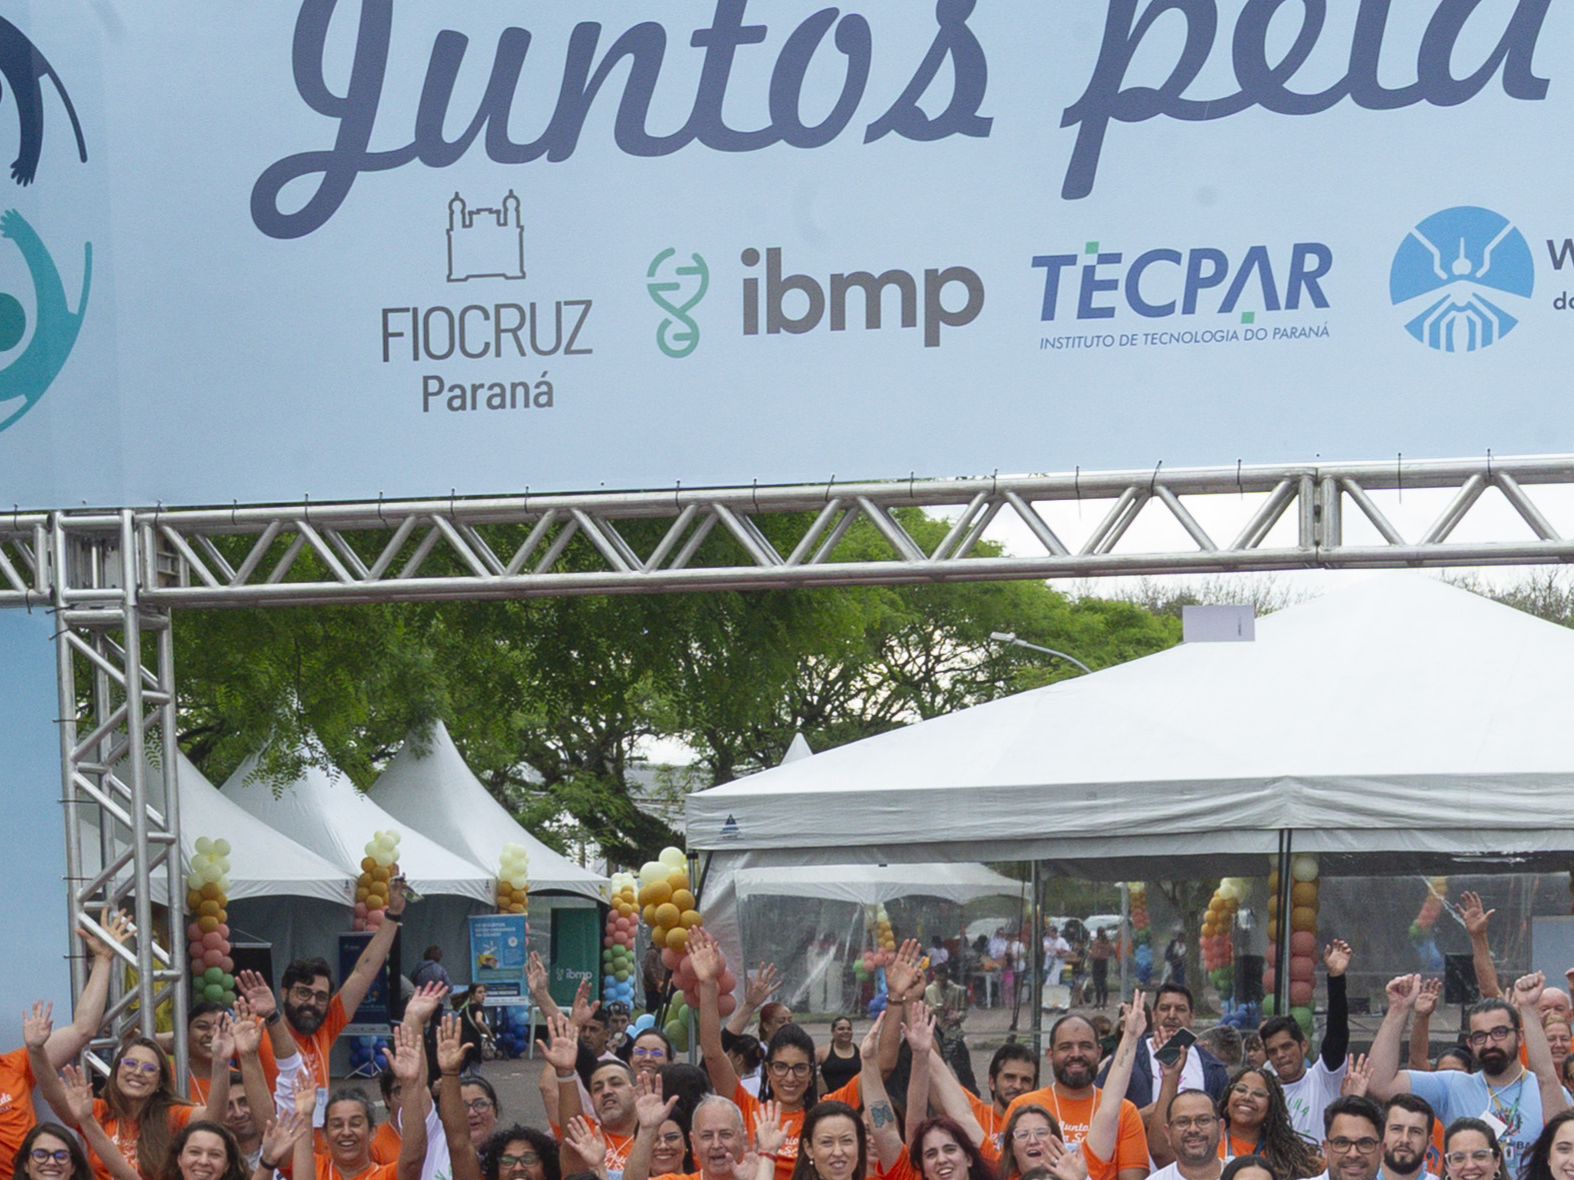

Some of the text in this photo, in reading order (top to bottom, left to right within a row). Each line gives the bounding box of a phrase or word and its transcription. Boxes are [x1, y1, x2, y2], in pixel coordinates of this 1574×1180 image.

[250, 0, 993, 239] Juntos
[1061, 0, 1550, 200] pela
[741, 247, 984, 347] ibmp
[381, 300, 593, 362] FIOCRUZ
[1040, 322, 1330, 350] INSTITUTO DE TECNOLOGIA DO PARANÁ
[422, 373, 554, 412] Paraná
